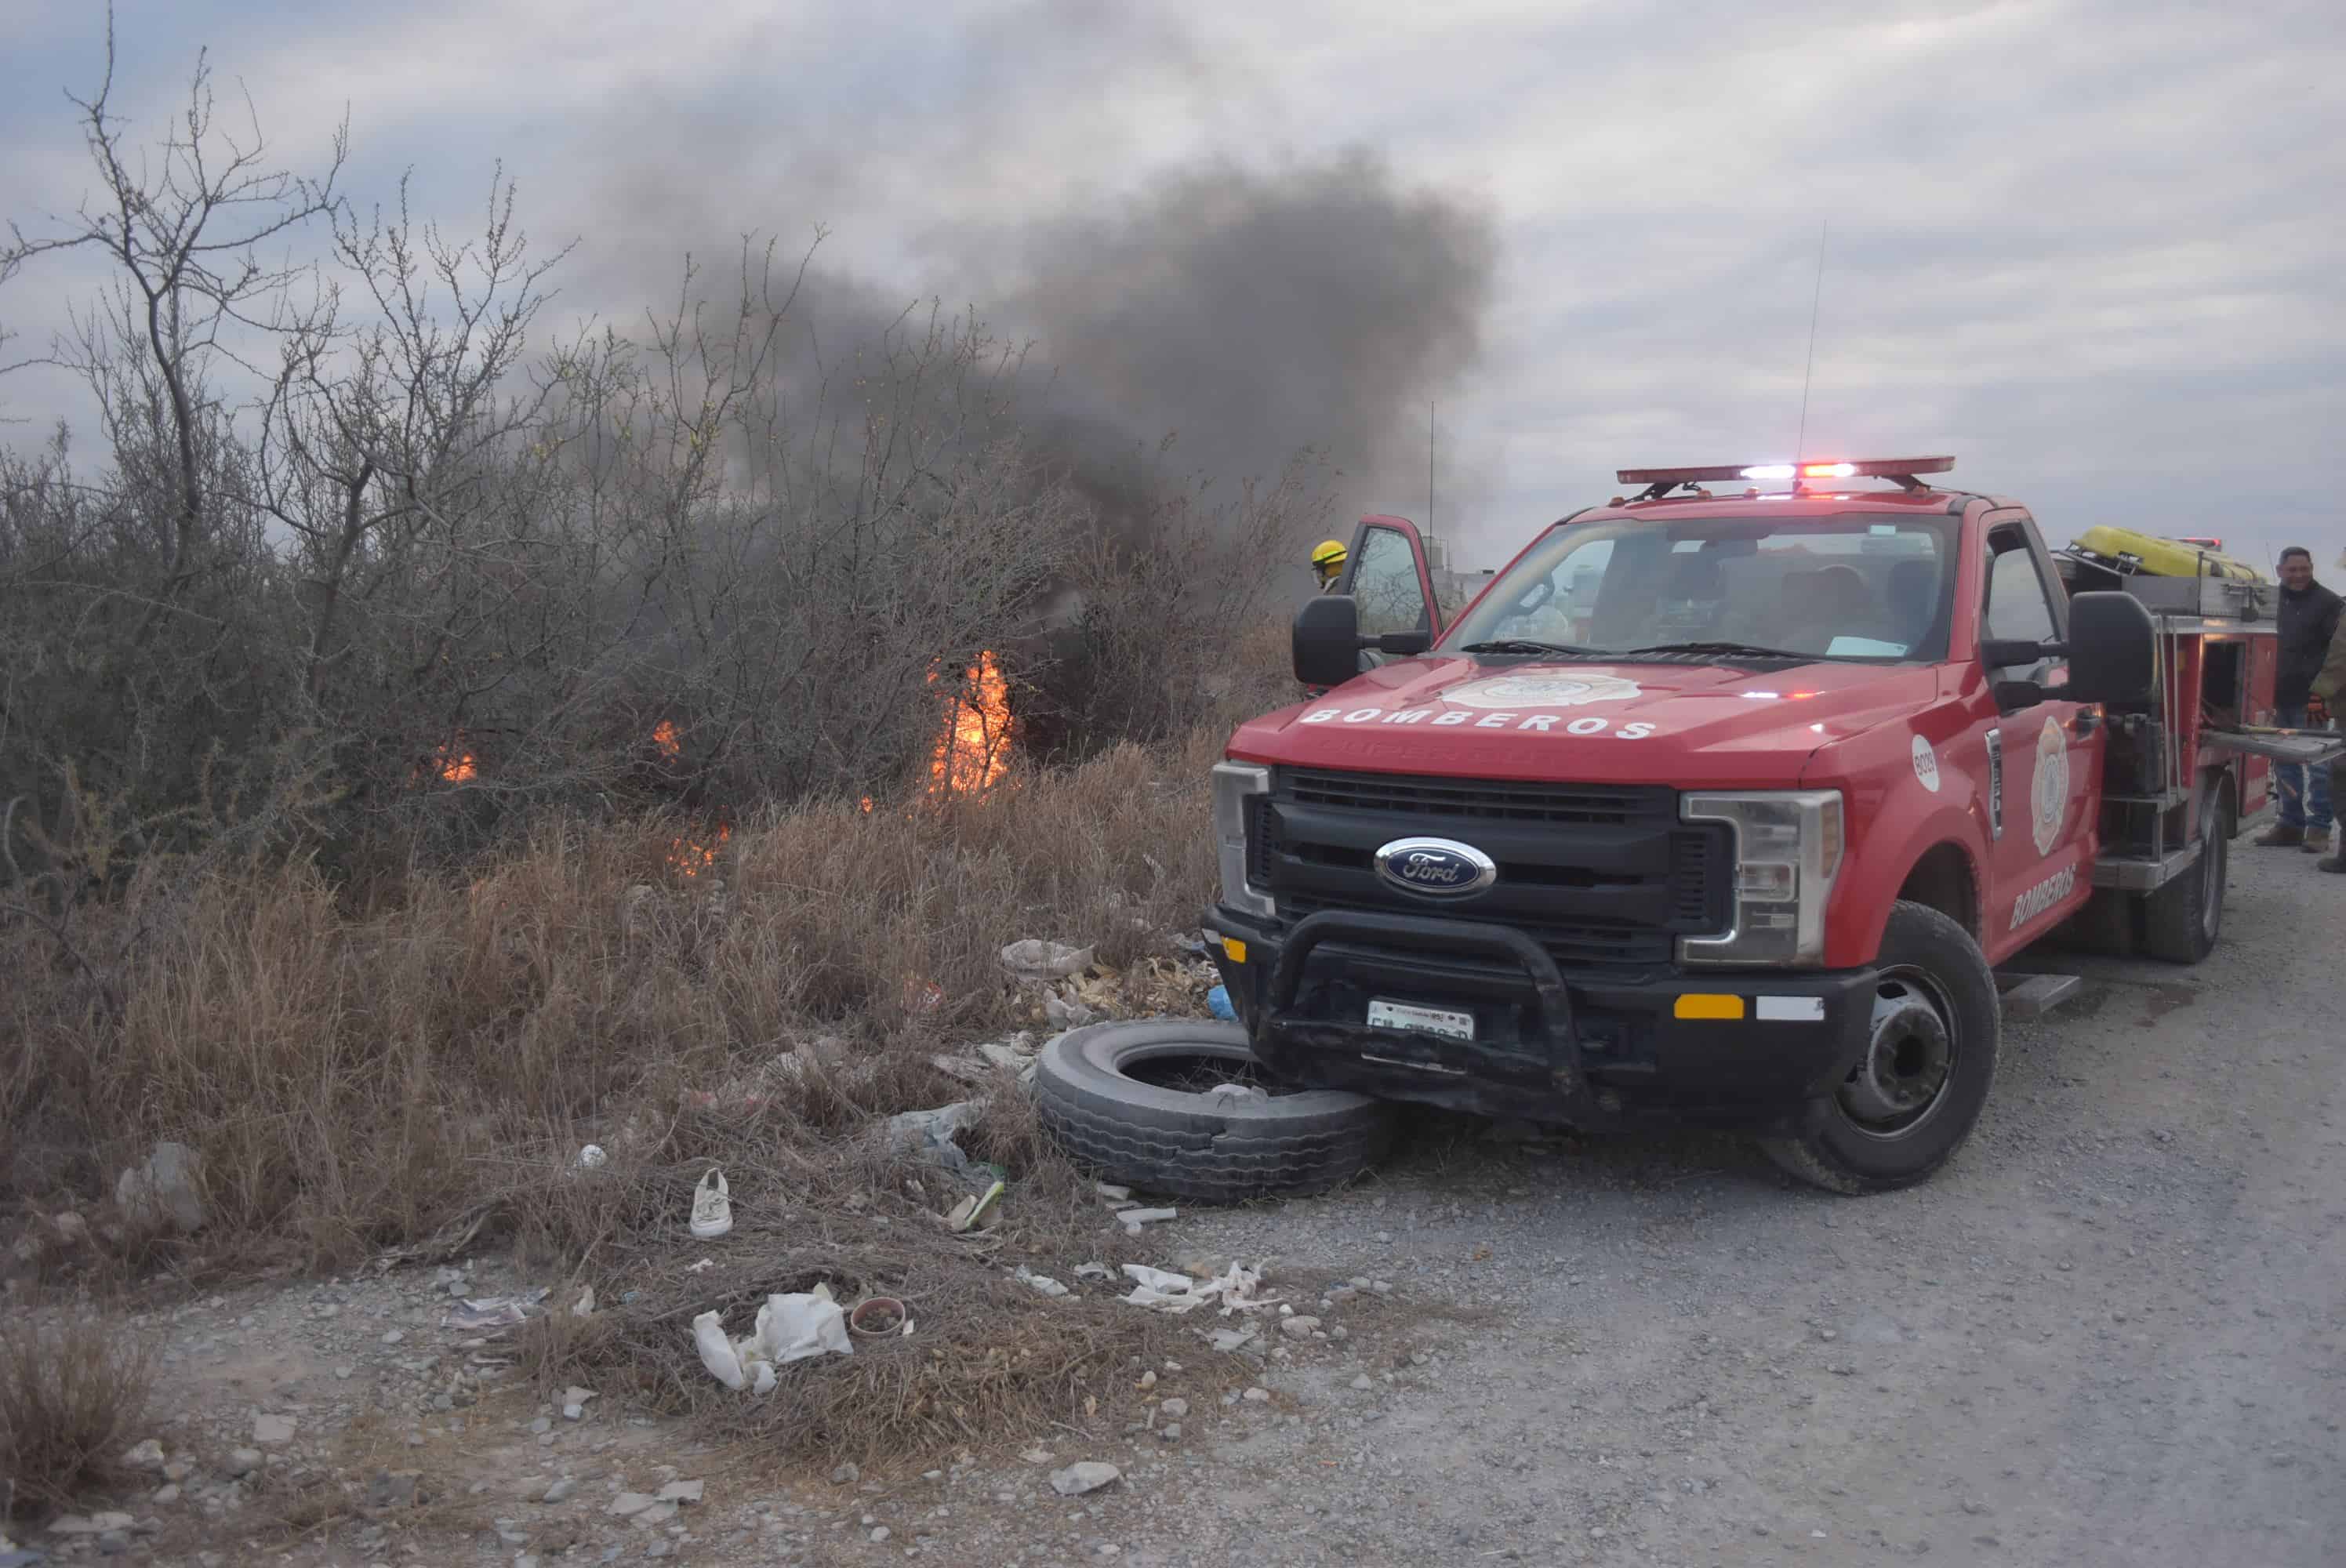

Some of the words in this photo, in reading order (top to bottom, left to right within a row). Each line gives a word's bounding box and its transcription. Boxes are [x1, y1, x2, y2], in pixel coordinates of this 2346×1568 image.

[1300, 708, 1657, 739] BOMBEROS
[1403, 852, 1460, 882] Ford
[2009, 862, 2076, 931] BOMBEROS
